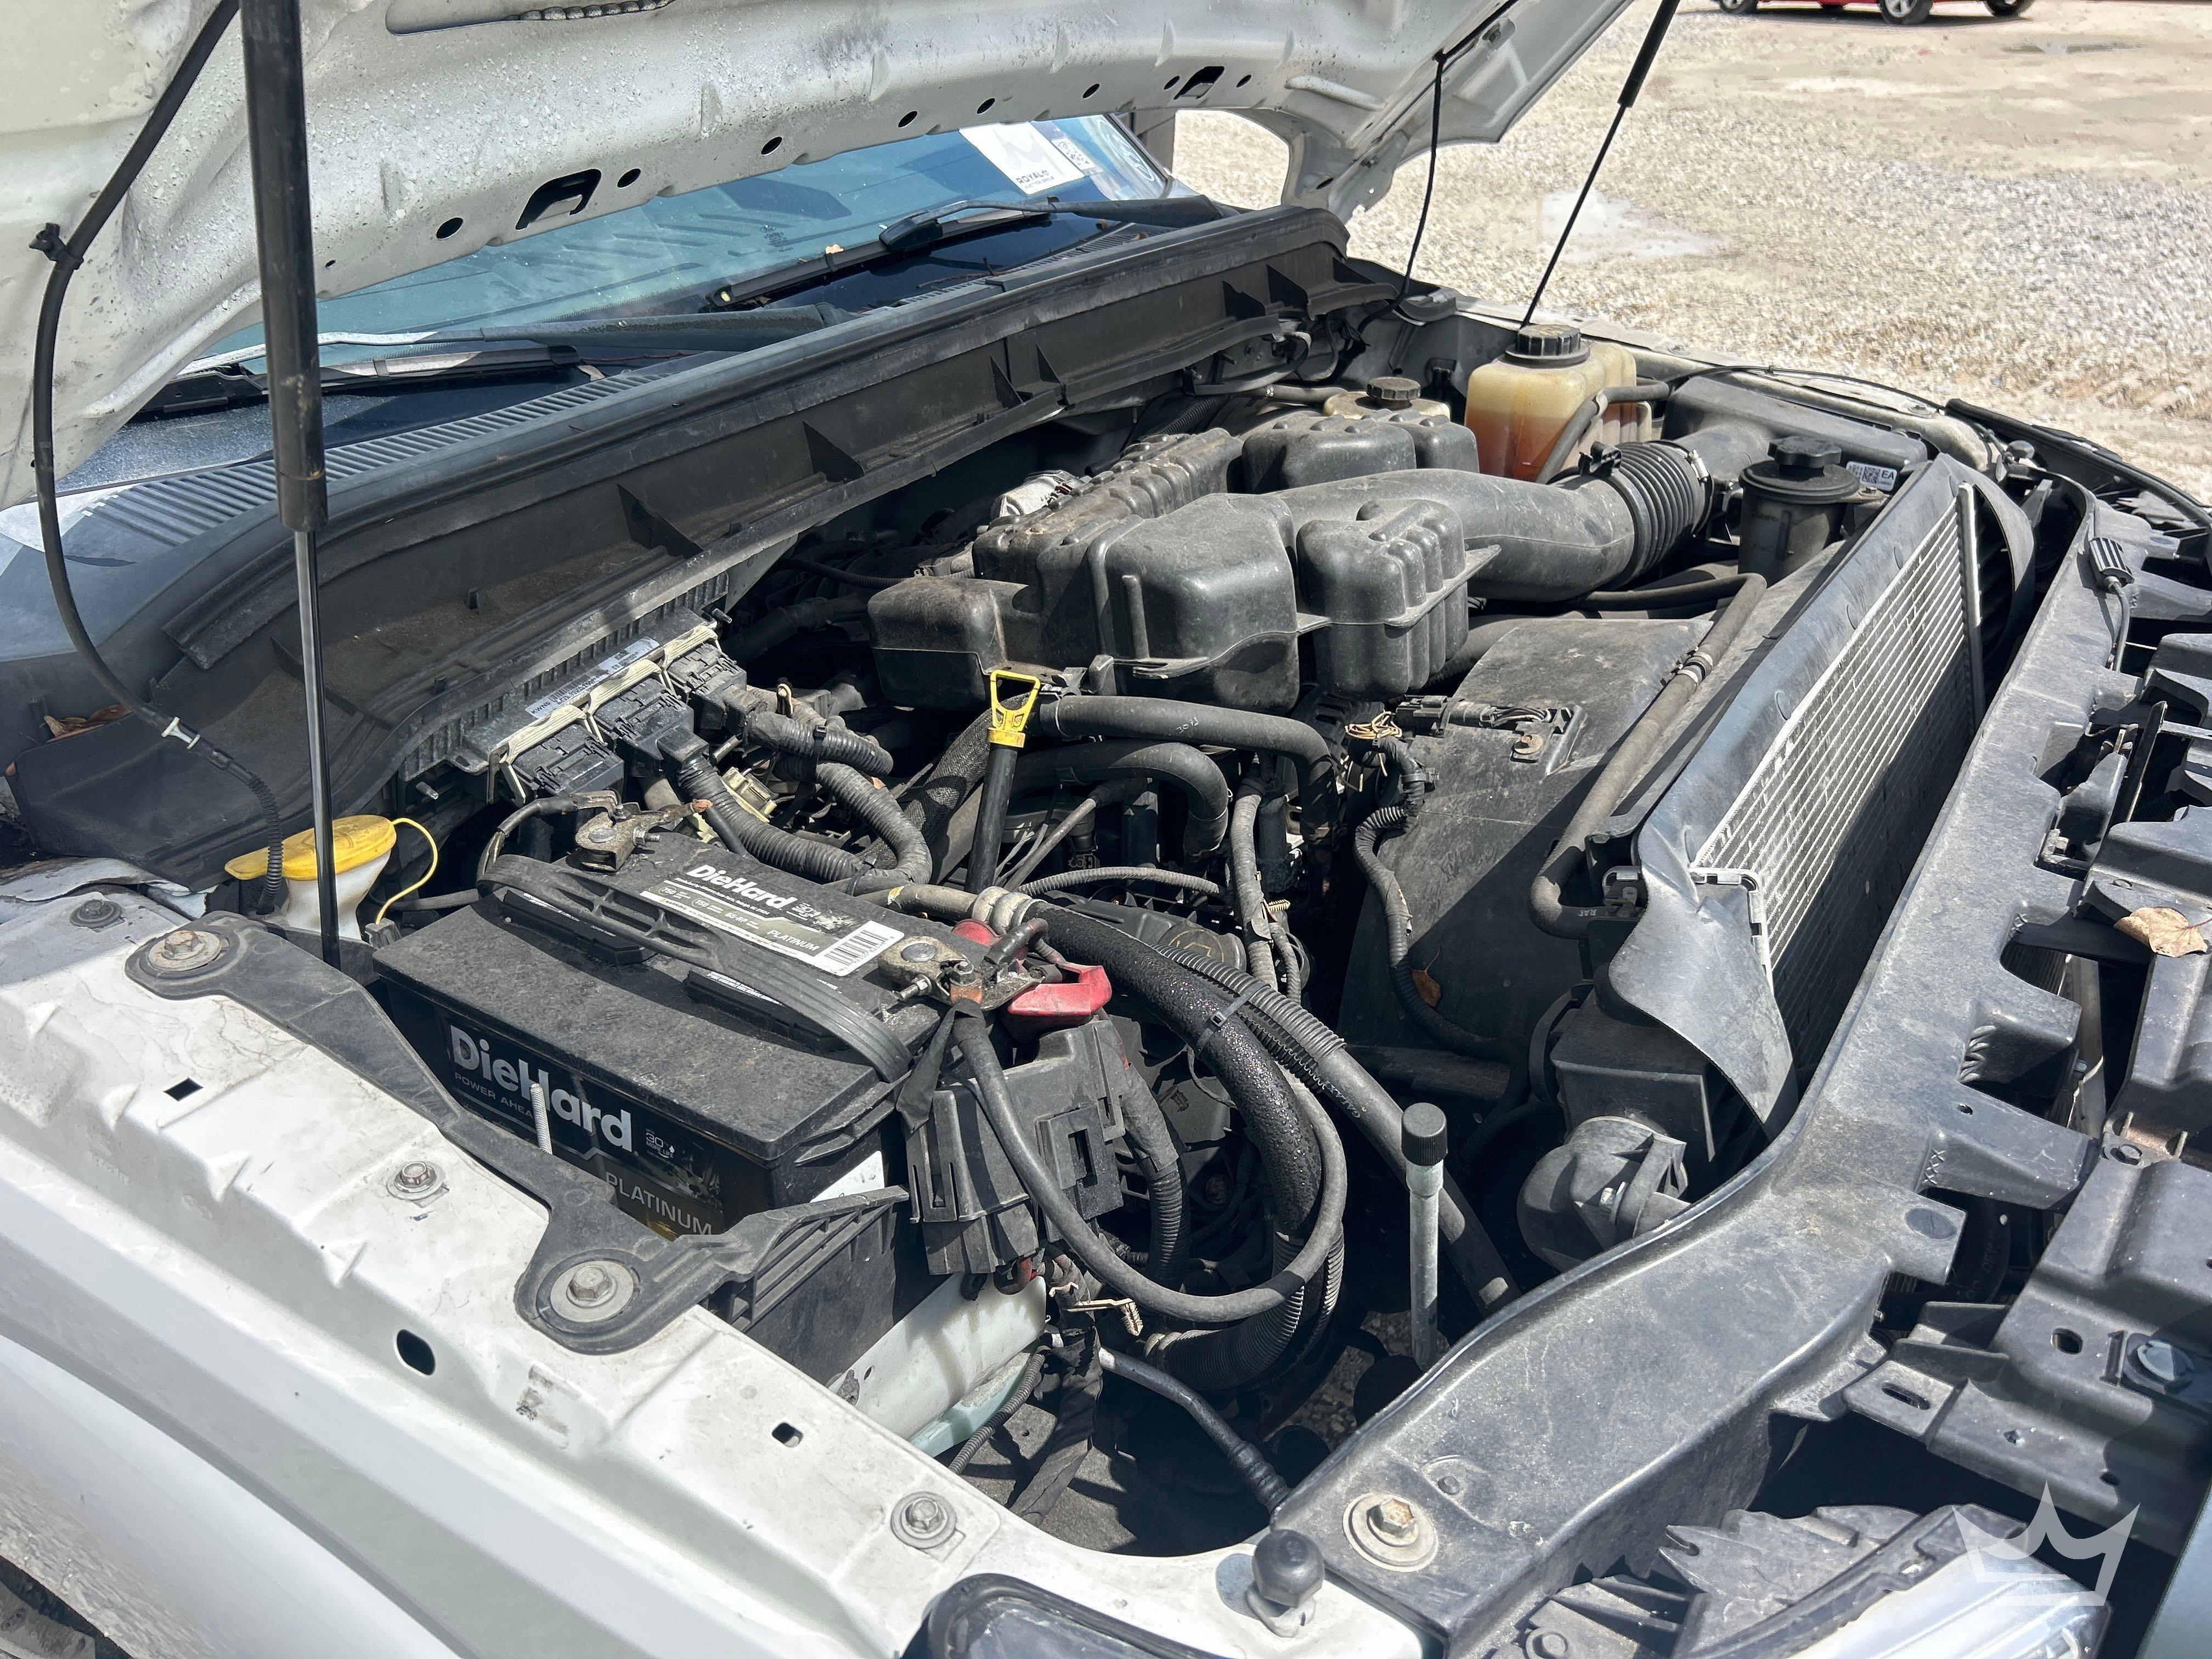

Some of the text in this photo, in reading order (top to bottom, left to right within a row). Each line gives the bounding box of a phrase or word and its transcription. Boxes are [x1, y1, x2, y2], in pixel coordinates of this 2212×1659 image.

[1881, 470, 1894, 480] EA
[686, 864, 798, 909] DieHard
[767, 929, 821, 952] PLATINUM
[450, 1024, 633, 1153] DieHard
[454, 1071, 496, 1101] POWER
[500, 1096, 536, 1120] AHEA
[605, 1171, 712, 1235] PLATINUM
